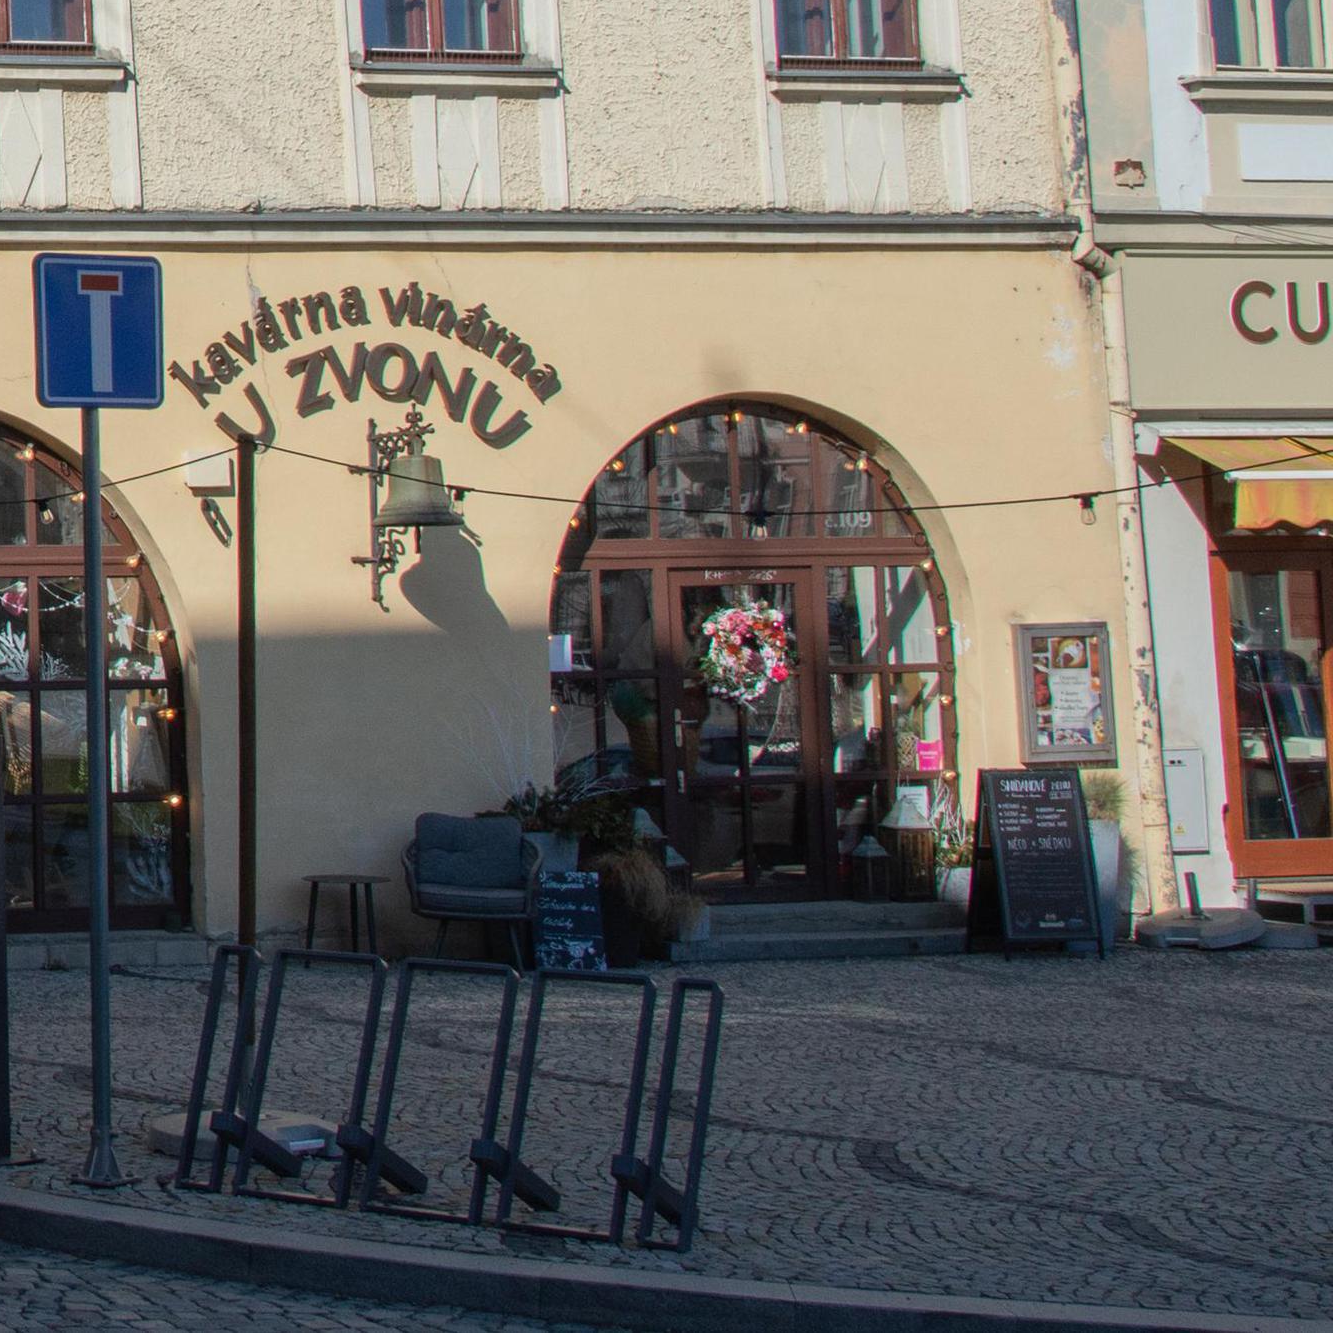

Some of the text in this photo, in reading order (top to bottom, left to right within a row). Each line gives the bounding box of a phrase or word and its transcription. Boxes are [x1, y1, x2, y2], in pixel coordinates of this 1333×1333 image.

[167, 281, 562, 409] kavárna vinárna
[1230, 280, 1331, 344] CU
[213, 341, 534, 454] U ZVONU
